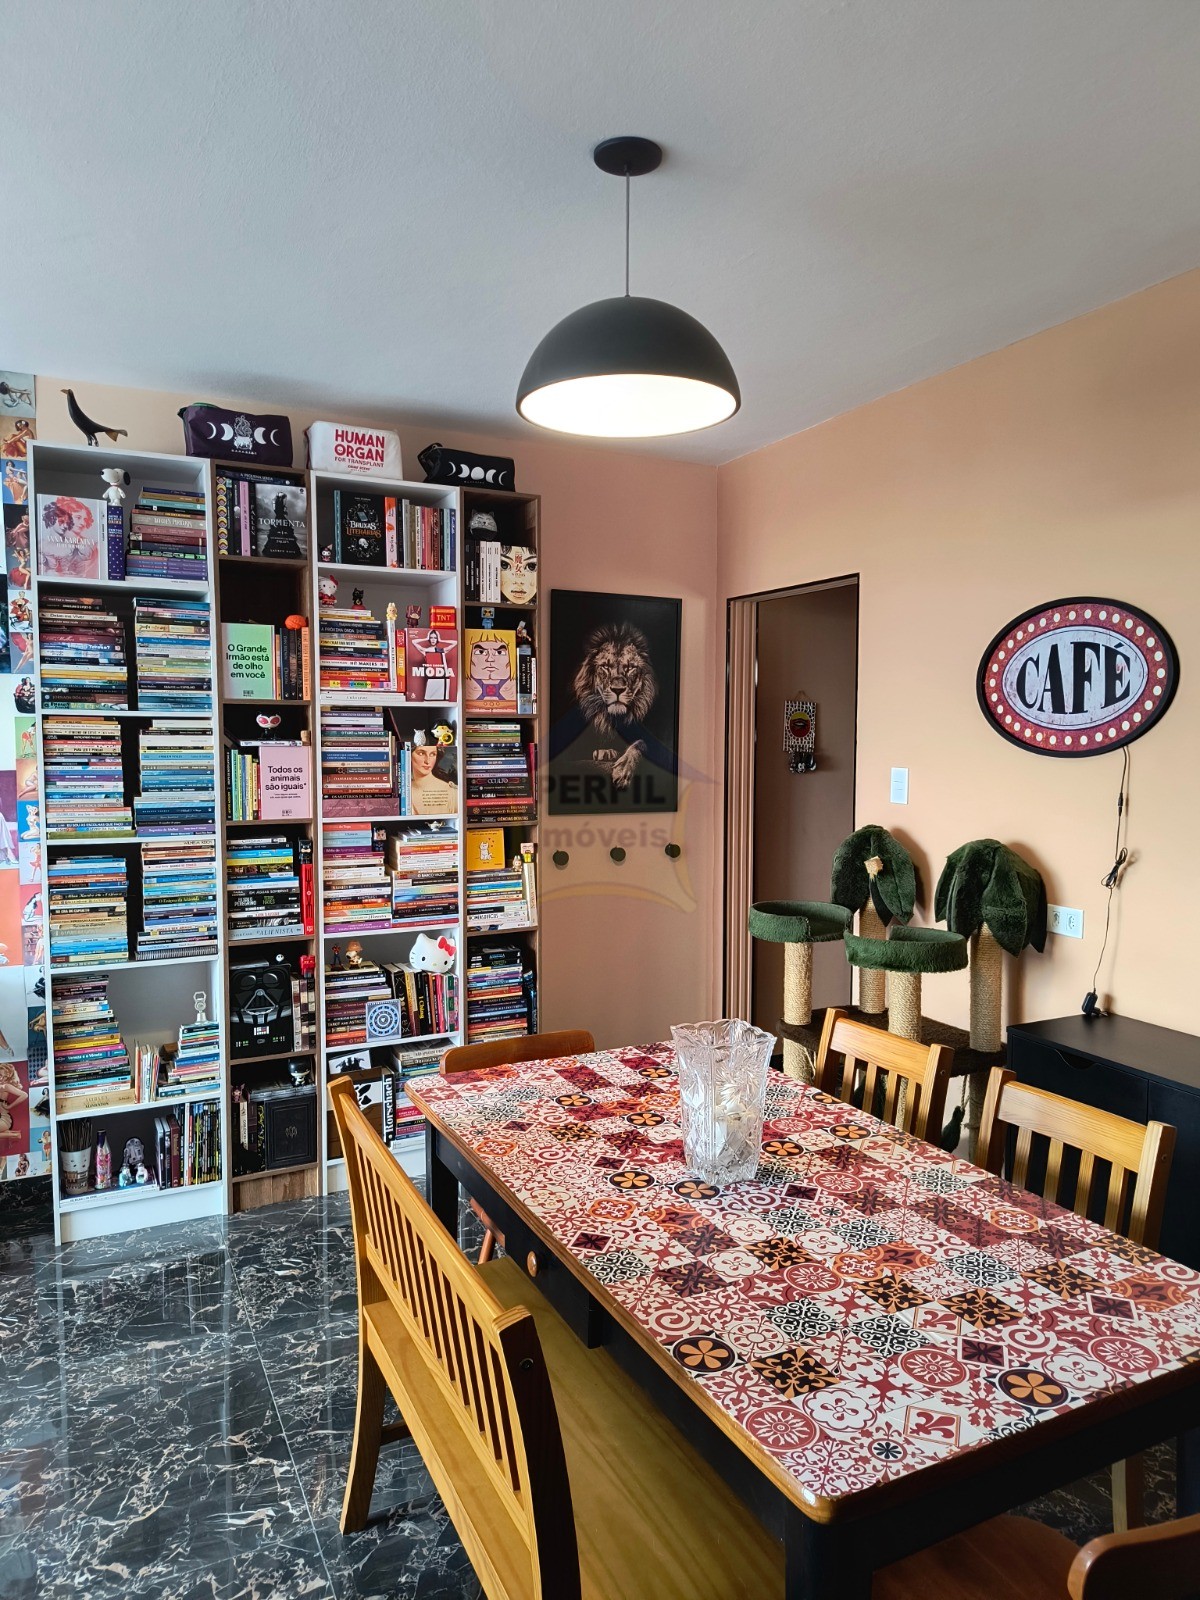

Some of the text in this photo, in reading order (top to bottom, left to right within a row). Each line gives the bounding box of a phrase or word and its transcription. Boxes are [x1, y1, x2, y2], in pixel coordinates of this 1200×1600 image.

[335, 429, 385, 449] HUMAN
[334, 443, 385, 463] ORGAN
[348, 458, 384, 468] TRANSPLANT
[258, 517, 306, 528] TORMENTA
[349, 520, 377, 530] BRUXAS
[227, 643, 267, 653] O Grande
[226, 652, 270, 662] Irmão está
[232, 662, 263, 670] de olho
[245, 671, 266, 679] você
[411, 666, 456, 678] MODA
[1016, 641, 1131, 715] CAFÉ
[267, 765, 292, 774] Todos
[270, 774, 300, 782] animais
[265, 782, 280, 791] são
[260, 928, 294, 936] ALIENISTA
[385, 1077, 394, 1133] Rorschach
